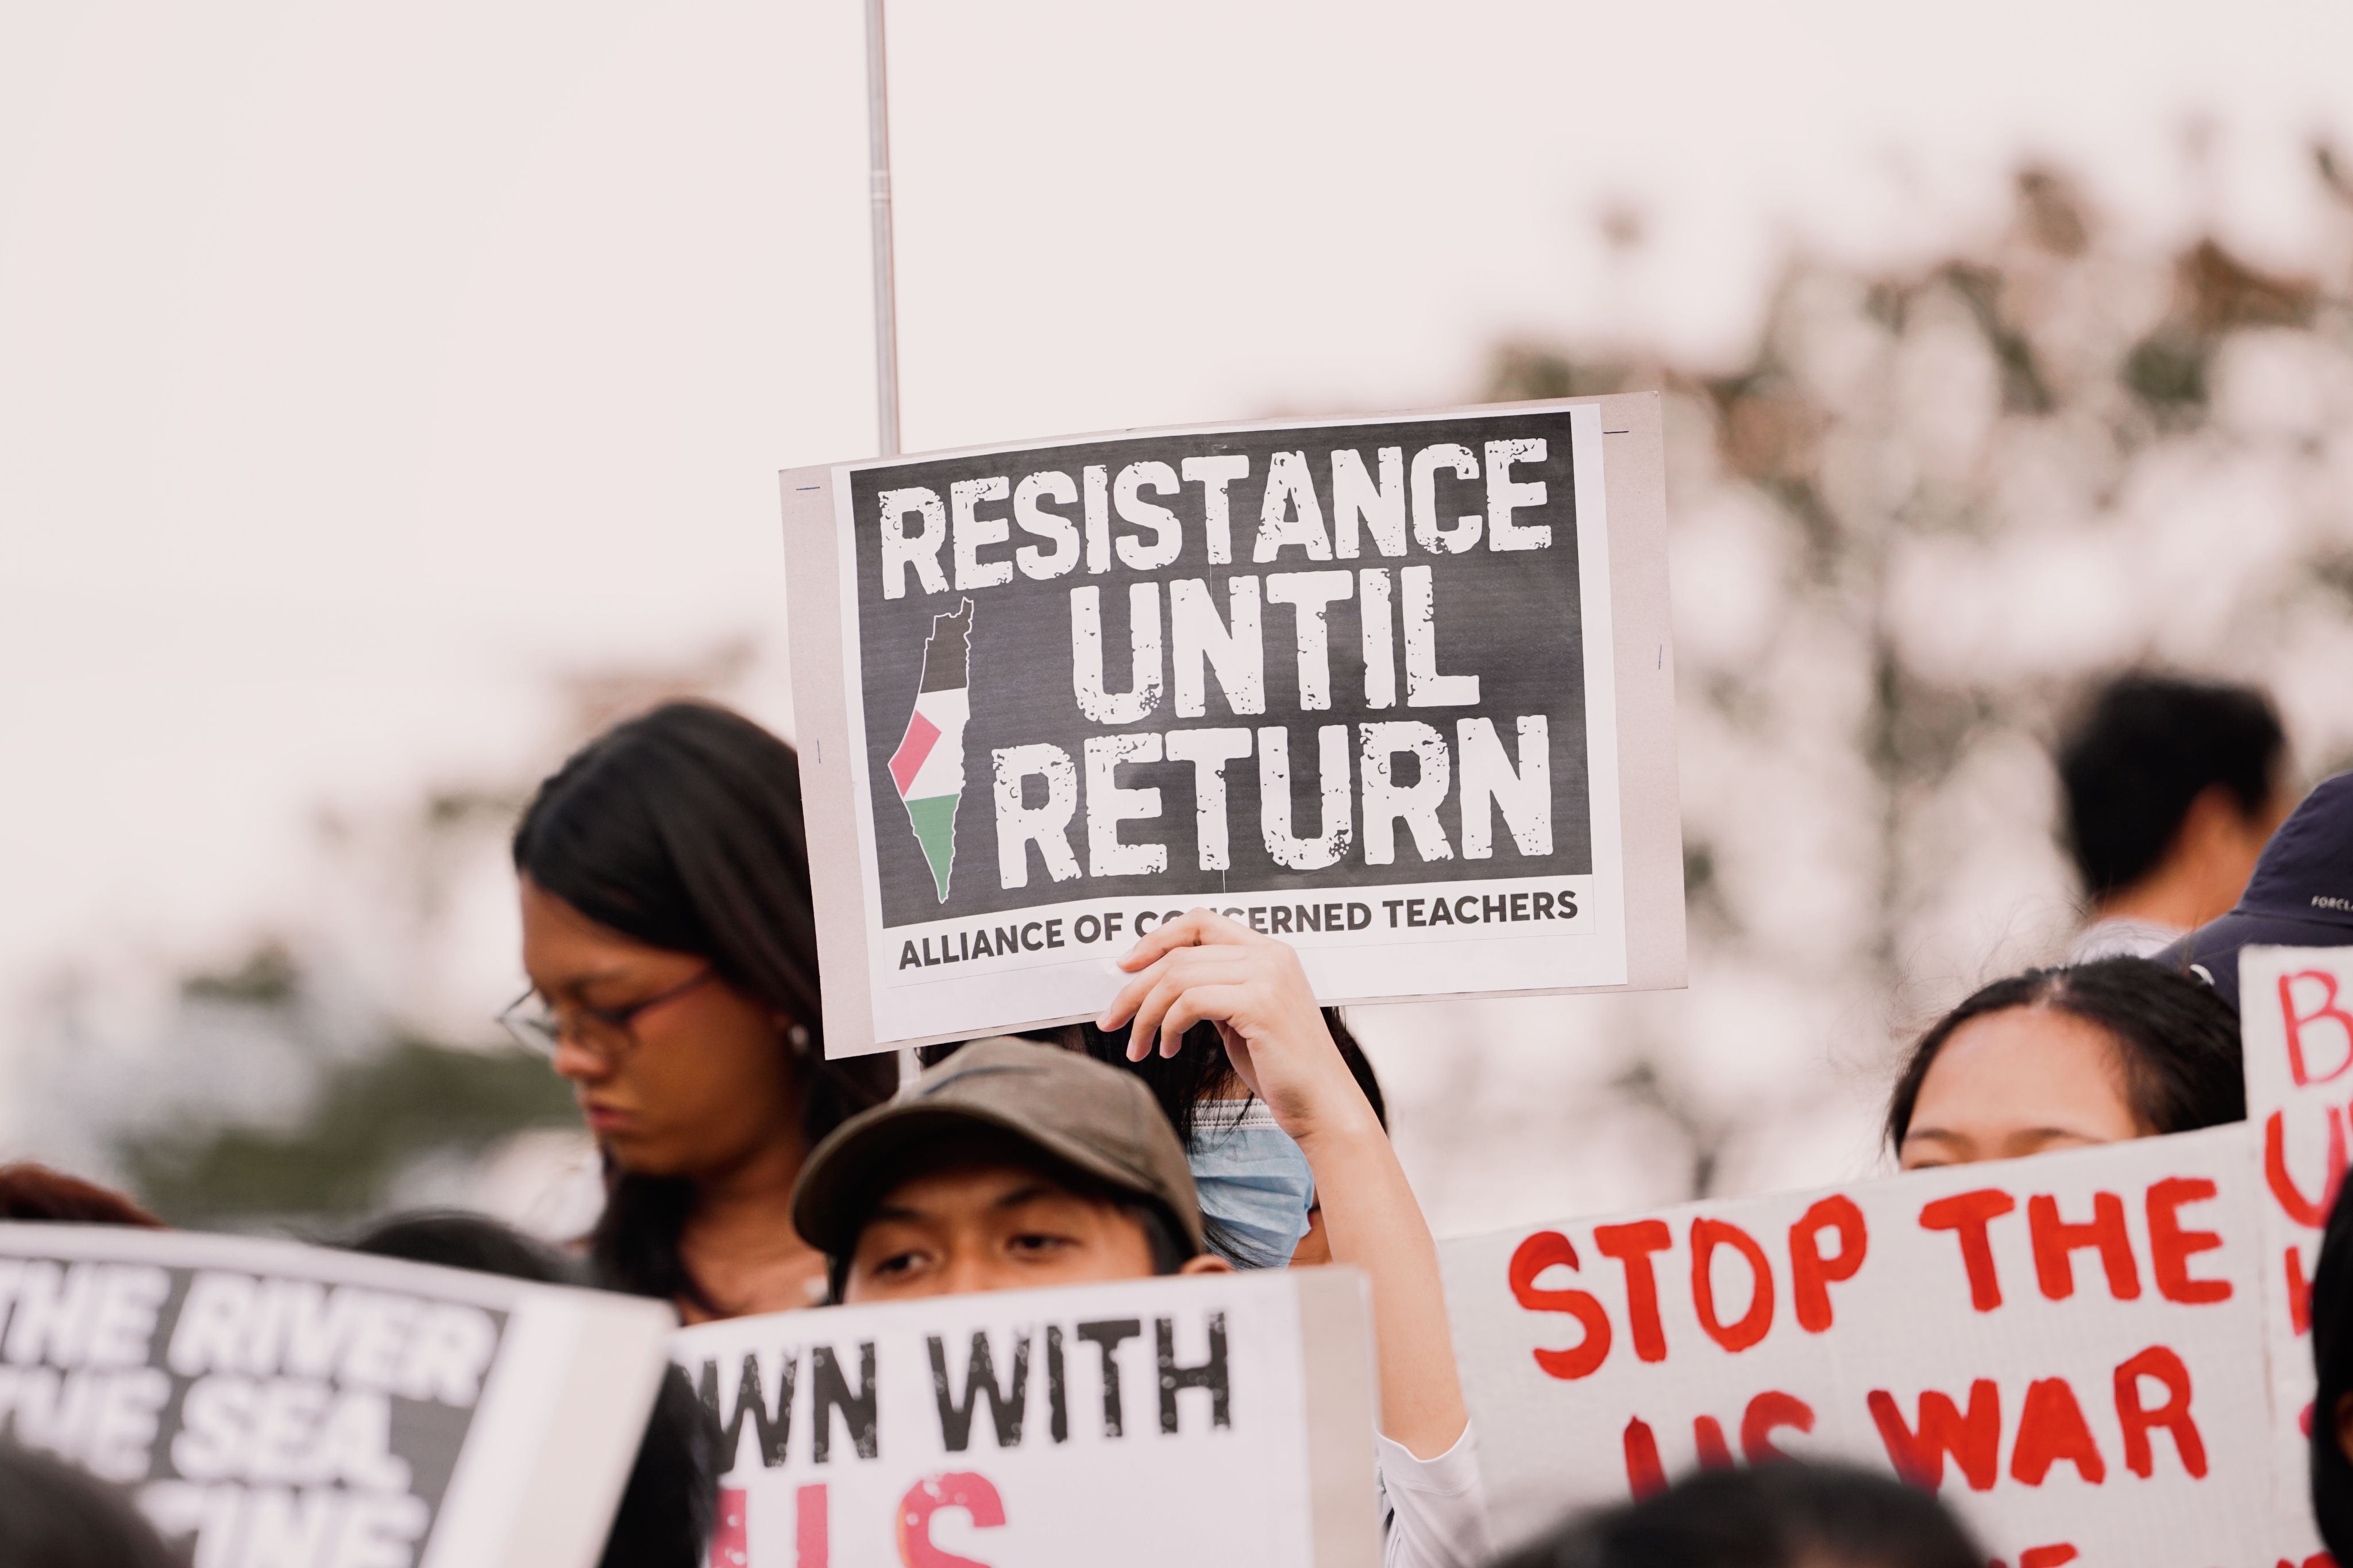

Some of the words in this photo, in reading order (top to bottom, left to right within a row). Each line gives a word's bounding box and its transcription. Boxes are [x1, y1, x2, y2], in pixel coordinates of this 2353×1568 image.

[878, 438, 1552, 600] RESISTANCE
[1070, 565, 1480, 724] UNTIL
[992, 715, 1553, 889] RETURN
[899, 918, 1065, 970] ALLIANCE
[1074, 912, 1123, 944] OF
[1135, 902, 1372, 938] CERNED
[1382, 890, 1578, 928] TEACHERS
[2310, 895, 2353, 912] FORCL
[0, 1261, 171, 1367] HE
[167, 1268, 497, 1407] RIVER
[1508, 1193, 1868, 1380] STOP
[1919, 1176, 2233, 1313] THE
[0, 1365, 171, 1483] HE
[927, 1312, 1231, 1452] WITH
[1867, 1344, 2208, 1500] WAR
